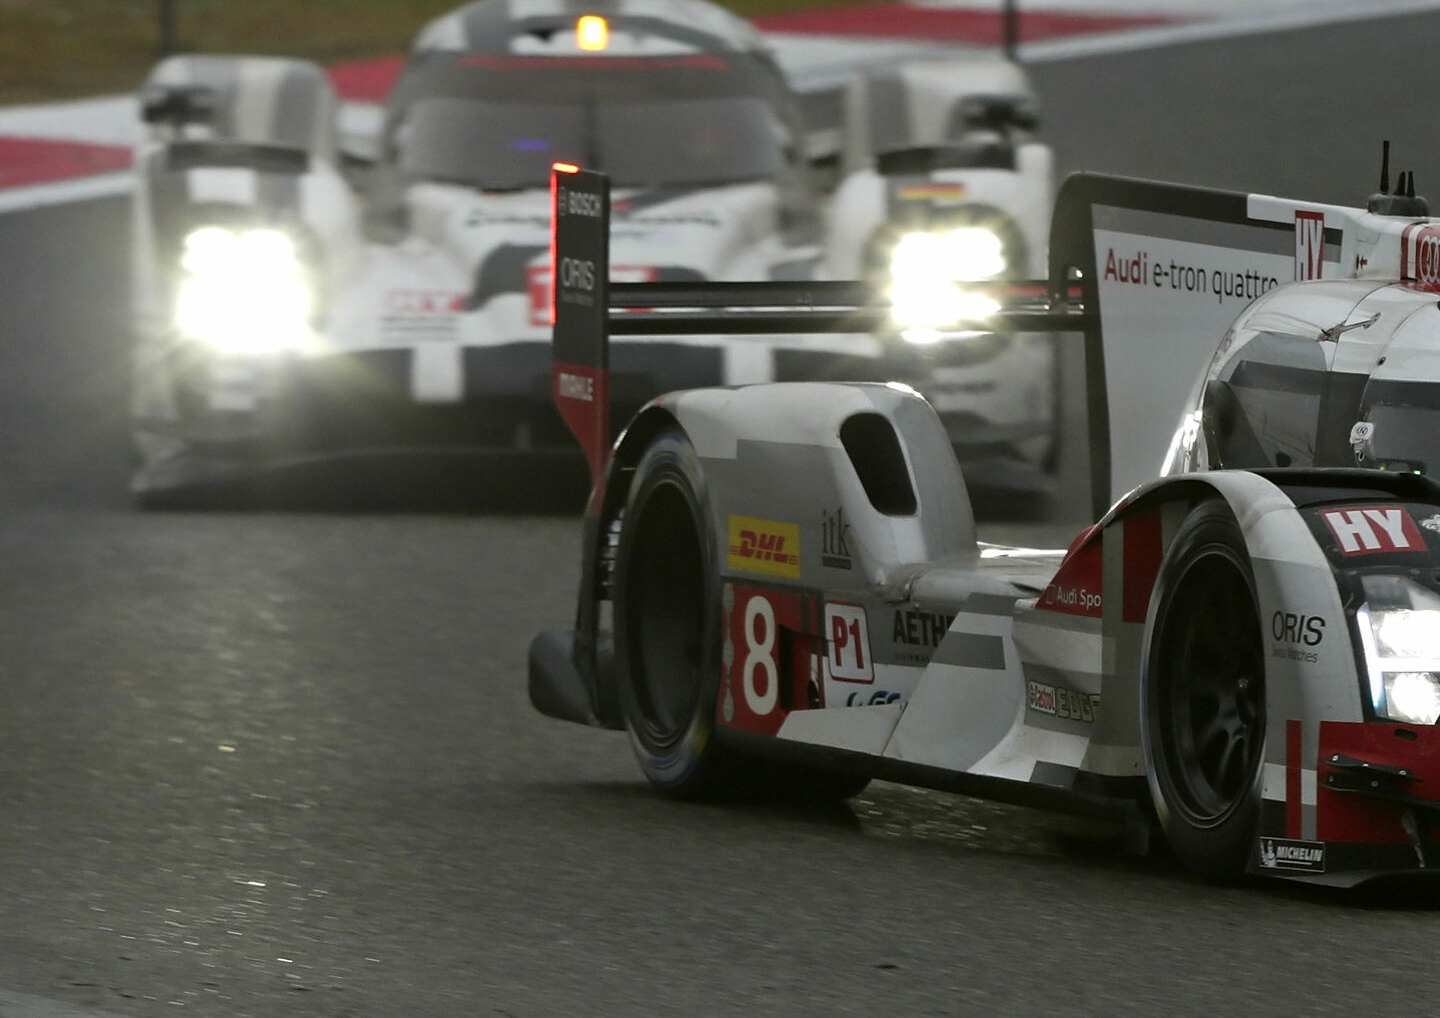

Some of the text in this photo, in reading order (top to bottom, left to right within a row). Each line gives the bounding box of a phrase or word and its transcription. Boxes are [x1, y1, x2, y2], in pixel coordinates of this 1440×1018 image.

[1296, 217, 1323, 281] HY
[561, 256, 596, 291] ORIS
[1105, 248, 1148, 286] Audi
[1153, 259, 1206, 293] e-tron
[738, 529, 790, 564] DHL
[1325, 509, 1410, 553] HY
[1057, 586, 1078, 605] Audi
[831, 614, 865, 670] P1
[1272, 611, 1326, 646] ORIS
[743, 594, 779, 716] 8
[1276, 845, 1323, 862] MICHELIN
